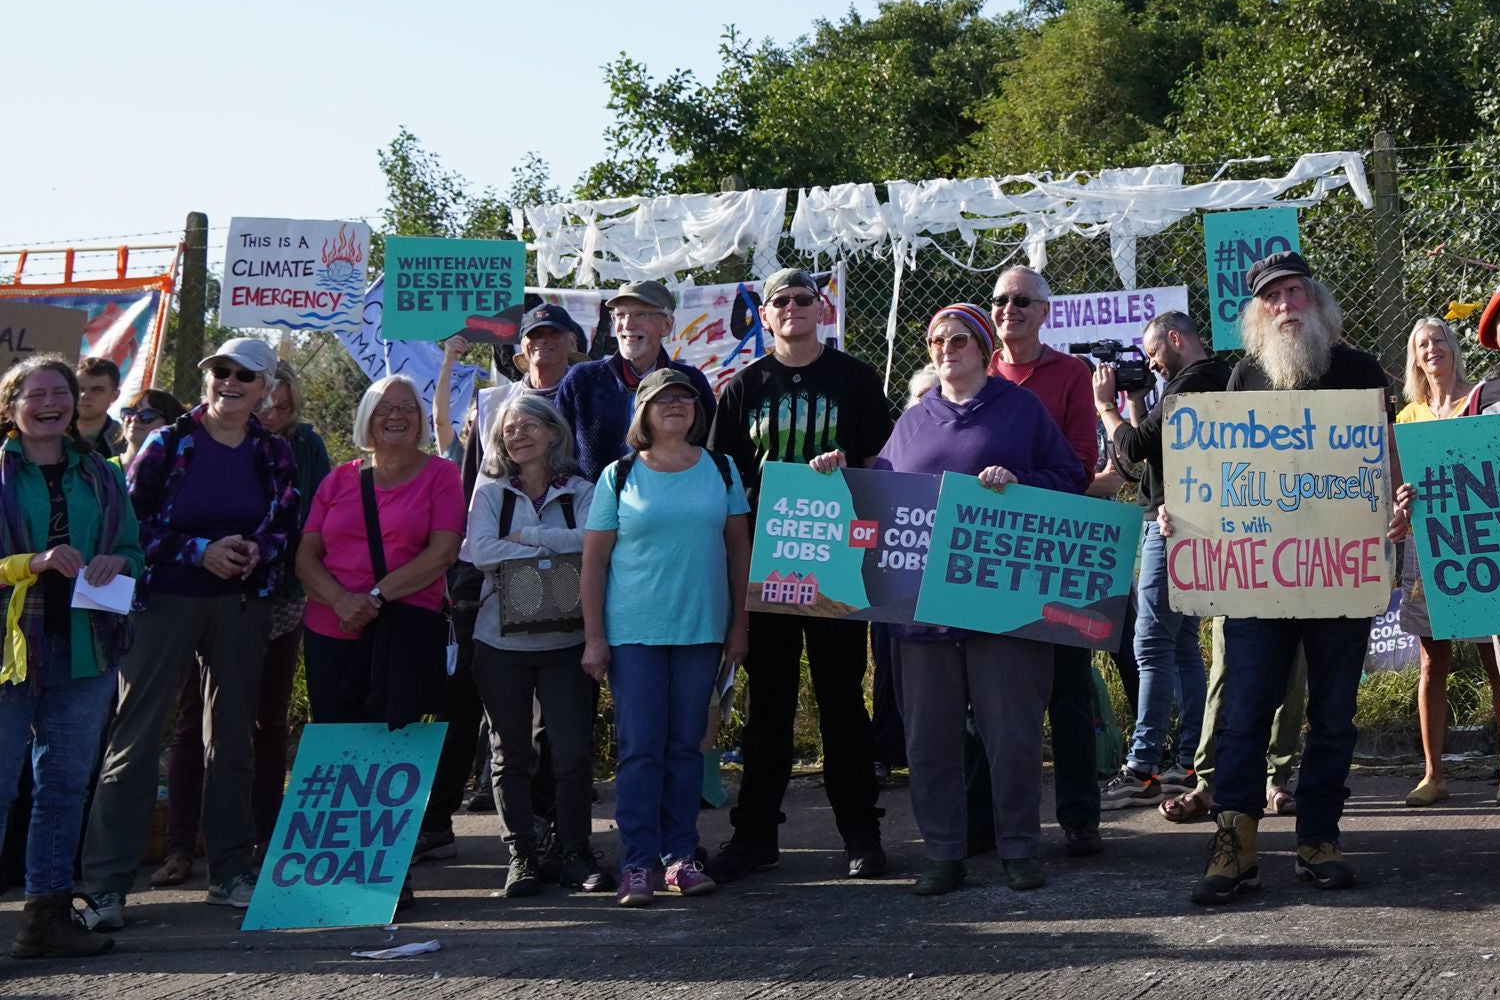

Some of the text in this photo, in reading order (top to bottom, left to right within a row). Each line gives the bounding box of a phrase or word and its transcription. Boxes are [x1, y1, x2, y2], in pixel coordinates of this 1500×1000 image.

[240, 233, 309, 249] THIS IS A
[231, 259, 315, 277] CLIMATE
[397, 256, 512, 270] WHITEHAVEN
[397, 272, 513, 289] DESERVES
[231, 286, 342, 312] EMERGENCY
[397, 290, 512, 312] BETTER
[1168, 406, 1385, 464] Dumbest way
[1179, 461, 1382, 512] to Kill yourself
[773, 497, 841, 519] 4,500
[765, 518, 844, 542] GREEN
[852, 526, 876, 541] or
[955, 503, 1121, 544] WHITEHAVEN
[1221, 516, 1273, 533] is with
[772, 541, 831, 562] JOBS
[949, 526, 1118, 570] DESERVES
[1168, 537, 1381, 591] CLIMATE CHANGE
[945, 553, 1115, 601] BETTER
[1369, 623, 1408, 641] COA
[1368, 635, 1415, 655] JOBS?
[297, 762, 421, 809] #NO
[282, 809, 414, 850] NEW
[271, 850, 395, 888] COAL
